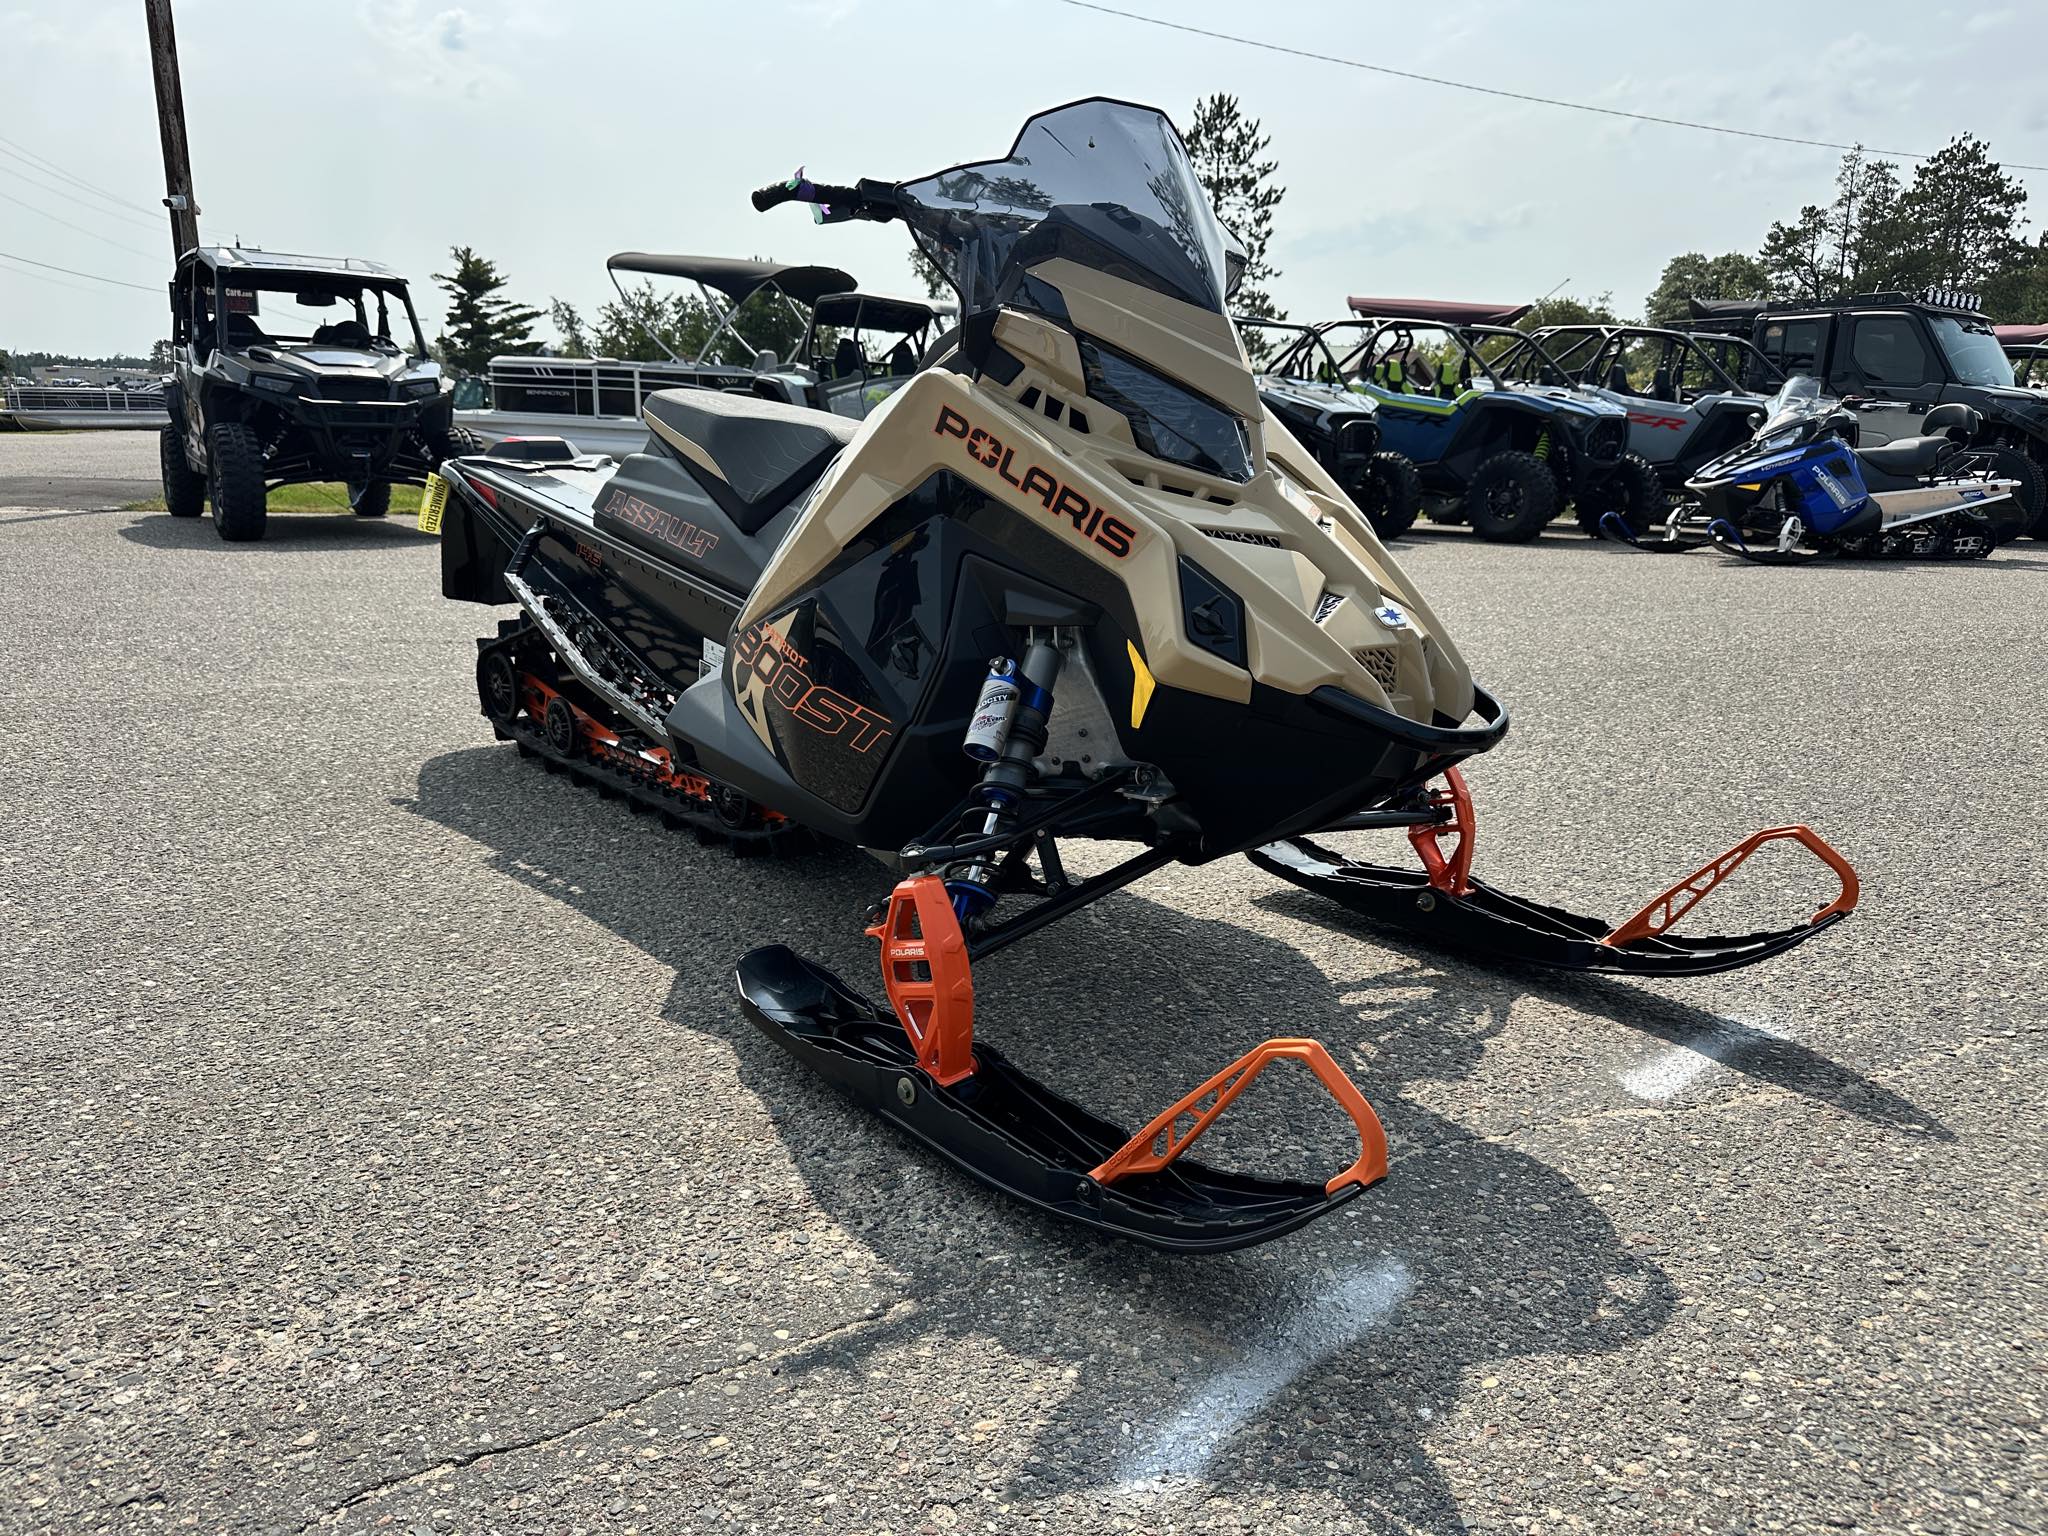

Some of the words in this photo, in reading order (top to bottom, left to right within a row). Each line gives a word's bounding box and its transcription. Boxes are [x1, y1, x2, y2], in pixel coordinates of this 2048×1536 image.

[526, 388, 570, 397] BENNINGTON
[934, 404, 1137, 559] POLARIS
[1760, 455, 1802, 472] VOYAGEUR
[1811, 465, 1847, 505] POLARIS
[425, 481, 446, 532] SUMMERIZED
[604, 489, 720, 558] ASSAULT
[763, 621, 809, 668] PATRIOT
[732, 624, 893, 753] BOOST
[890, 947, 925, 956] POLARIS
[1108, 1130, 1149, 1168] POLARIS
